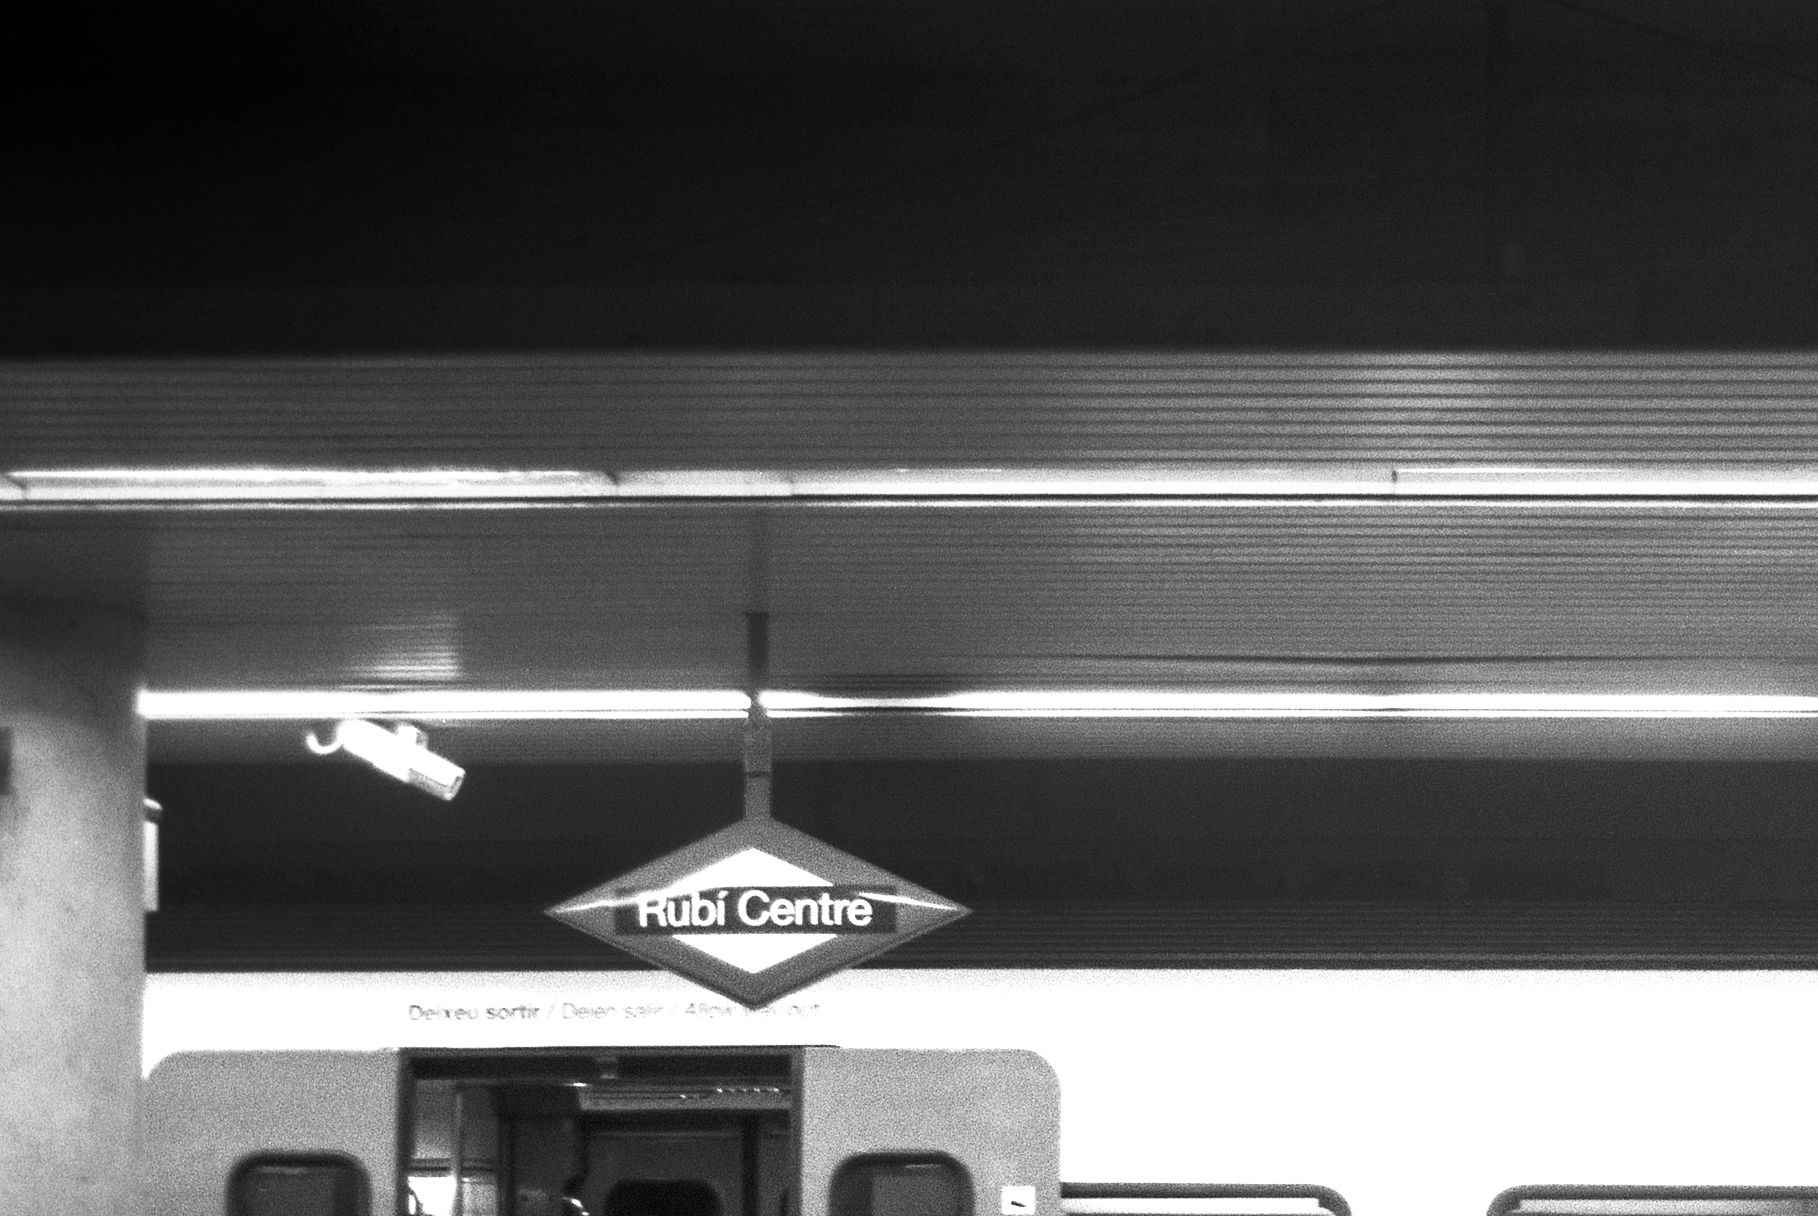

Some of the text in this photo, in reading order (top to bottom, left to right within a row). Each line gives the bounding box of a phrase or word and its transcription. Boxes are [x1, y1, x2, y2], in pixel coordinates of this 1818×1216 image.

[637, 889, 873, 928] Rubí Centre
[485, 1003, 541, 1020] sortir
